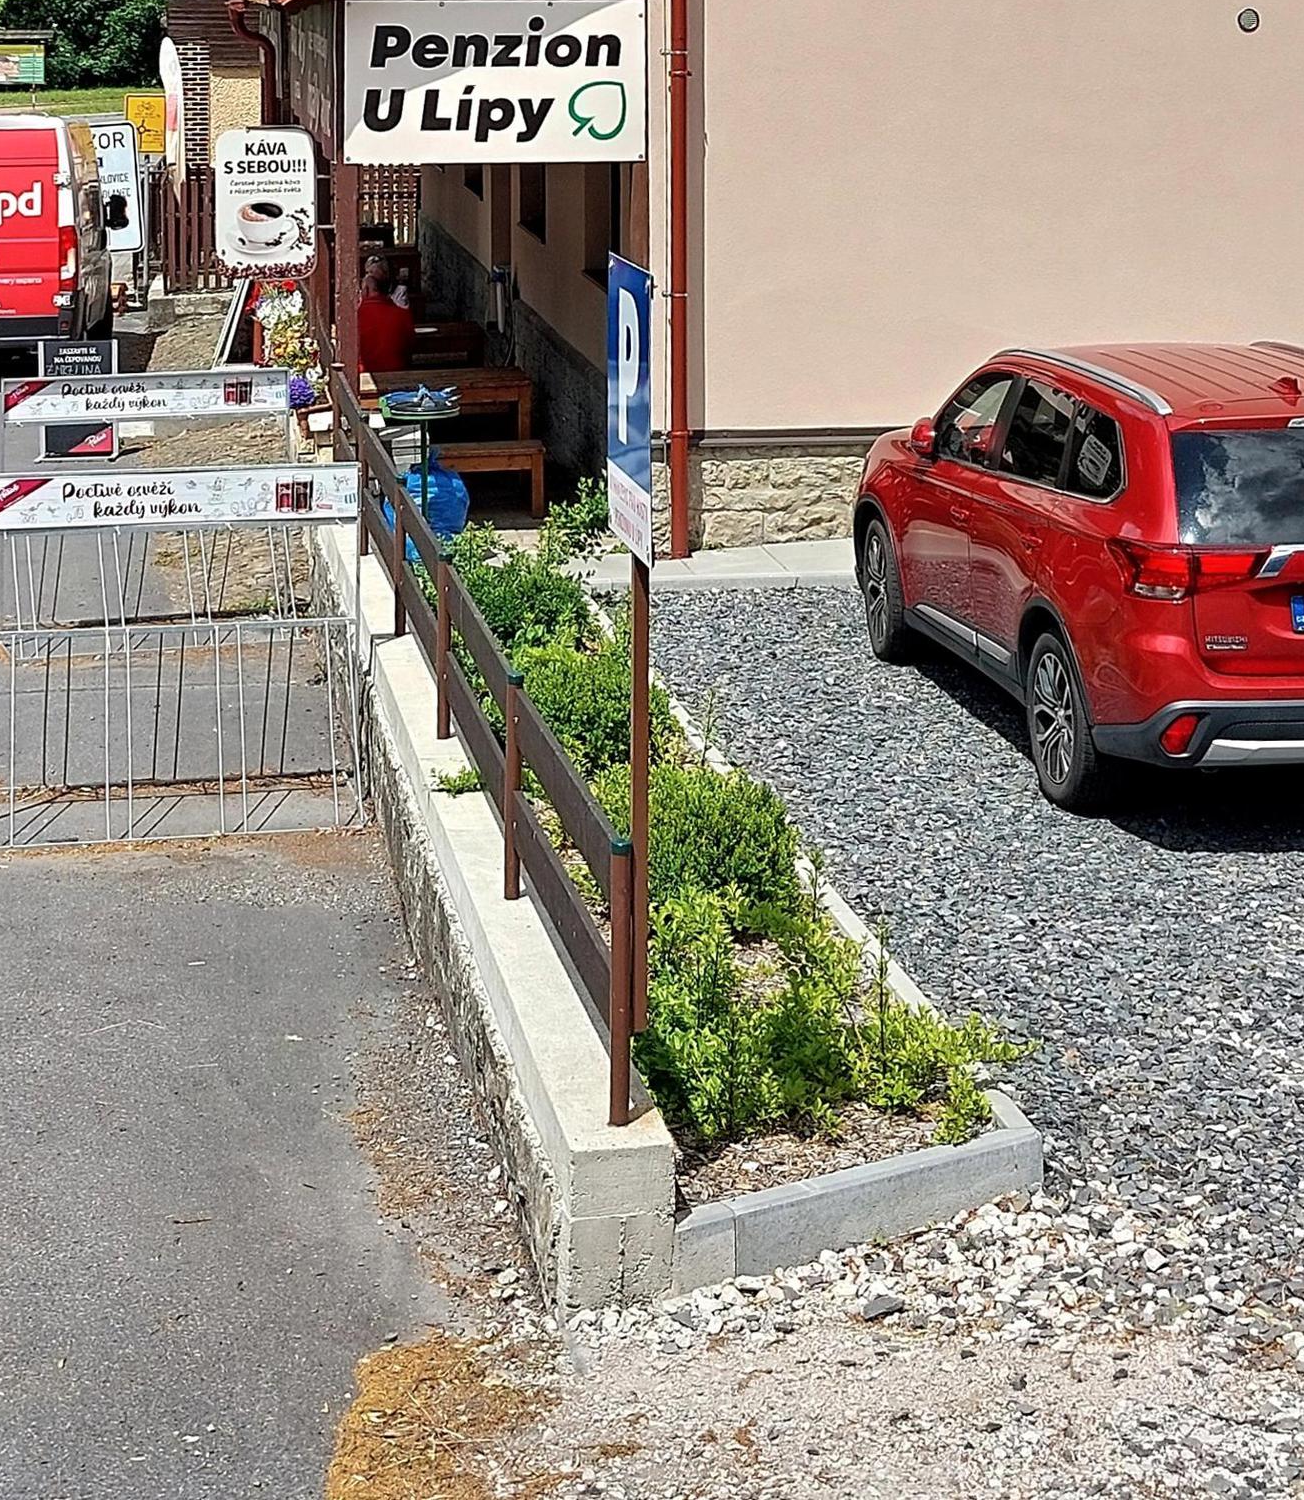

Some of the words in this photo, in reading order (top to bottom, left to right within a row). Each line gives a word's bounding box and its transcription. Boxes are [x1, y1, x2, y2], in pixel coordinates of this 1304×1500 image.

[370, 16, 621, 69] Penzion
[363, 88, 405, 132] U
[421, 85, 555, 143] Lípy
[245, 139, 288, 156] KÁVA
[223, 160, 234, 174] S
[237, 159, 307, 174] SEBOU!!!
[618, 286, 640, 445] P
[85, 396, 125, 412] každý
[128, 396, 168, 411] výkon
[62, 482, 123, 503] Poctivě
[127, 480, 175, 497] osvěží
[93, 499, 146, 519] každý
[150, 498, 202, 518] výkon
